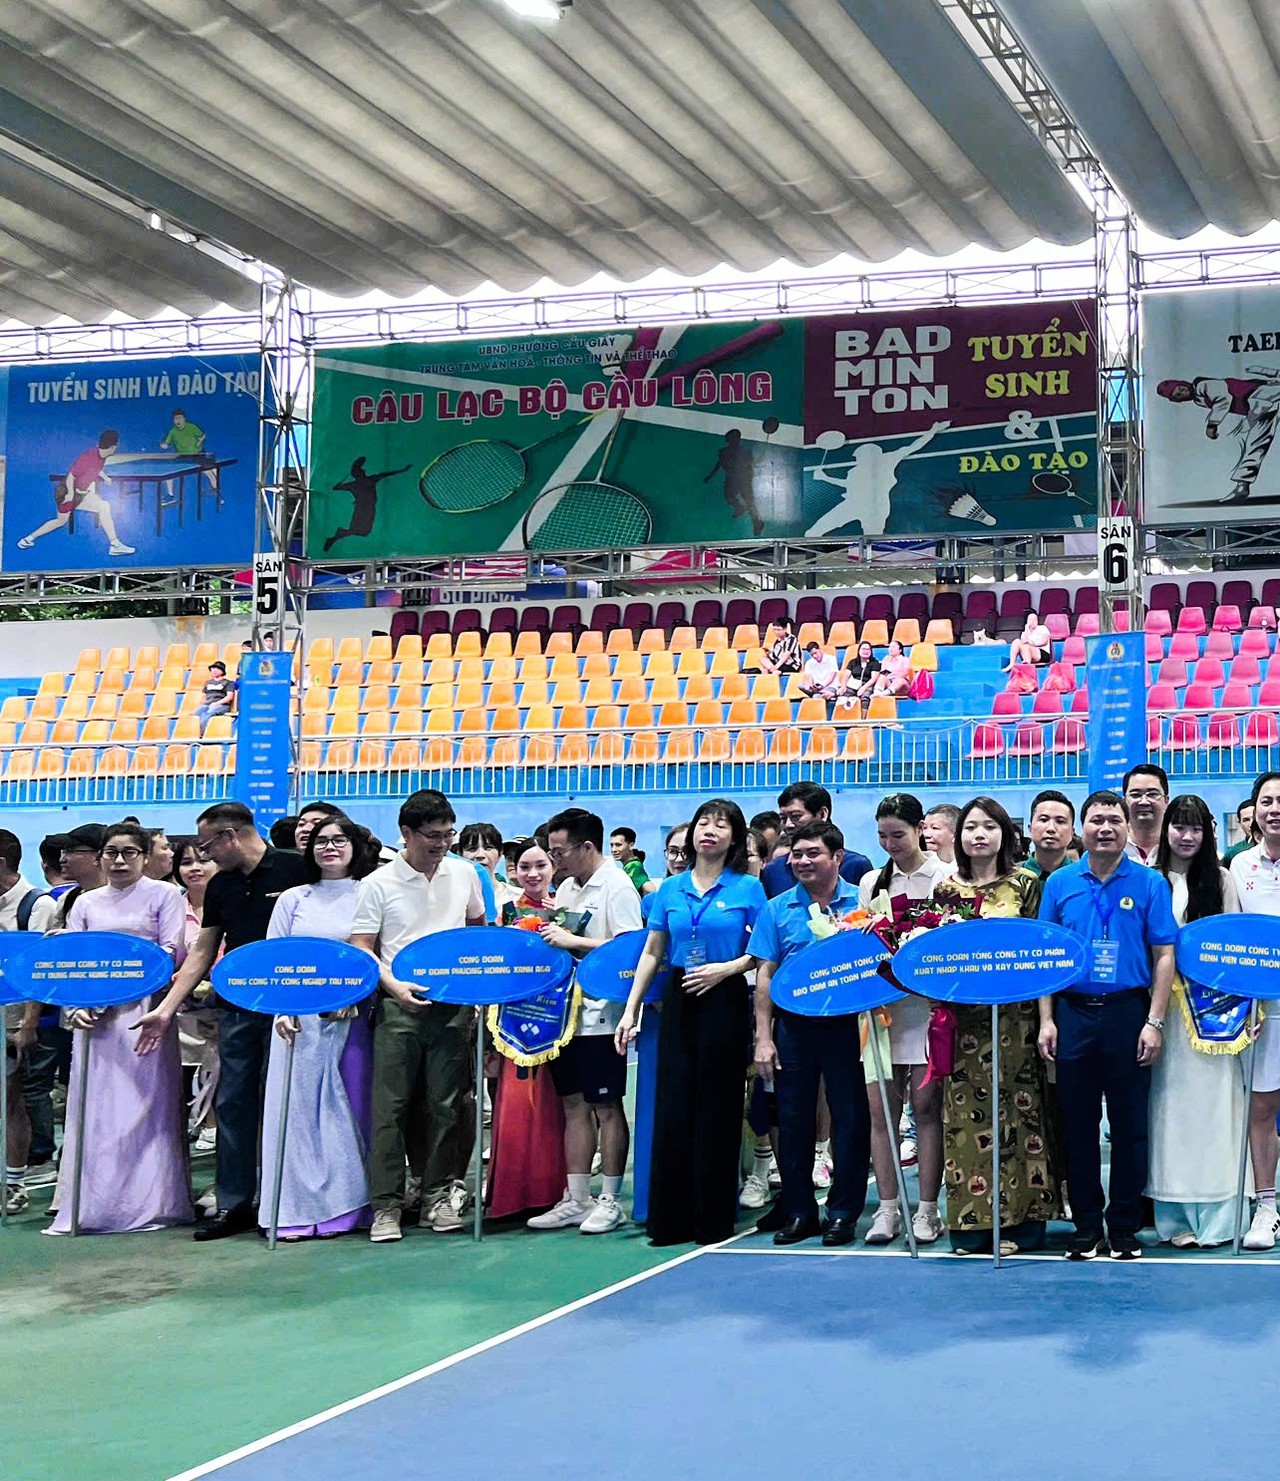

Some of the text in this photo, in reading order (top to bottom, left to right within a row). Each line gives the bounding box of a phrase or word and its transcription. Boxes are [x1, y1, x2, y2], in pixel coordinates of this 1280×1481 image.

[479, 345, 509, 356] UBND
[834, 325, 951, 359] BAD
[967, 317, 1090, 363] TUYỂN
[420, 364, 455, 375] TRUNG
[834, 355, 935, 388] MIN
[984, 370, 1071, 399] SINH
[28, 368, 261, 404] TUYỂN SINH VÀ ĐÀO TẠO
[351, 368, 774, 426] CÂU LẠC BỘ CẦU LÔNG
[834, 384, 949, 416] TON
[1004, 410, 1041, 440] &
[958, 450, 1089, 475] ĐÀO TẠO
[1100, 520, 1132, 539] SÂN
[255, 557, 282, 574] SÂN
[1103, 542, 1129, 585] 6
[257, 576, 278, 615] 5
